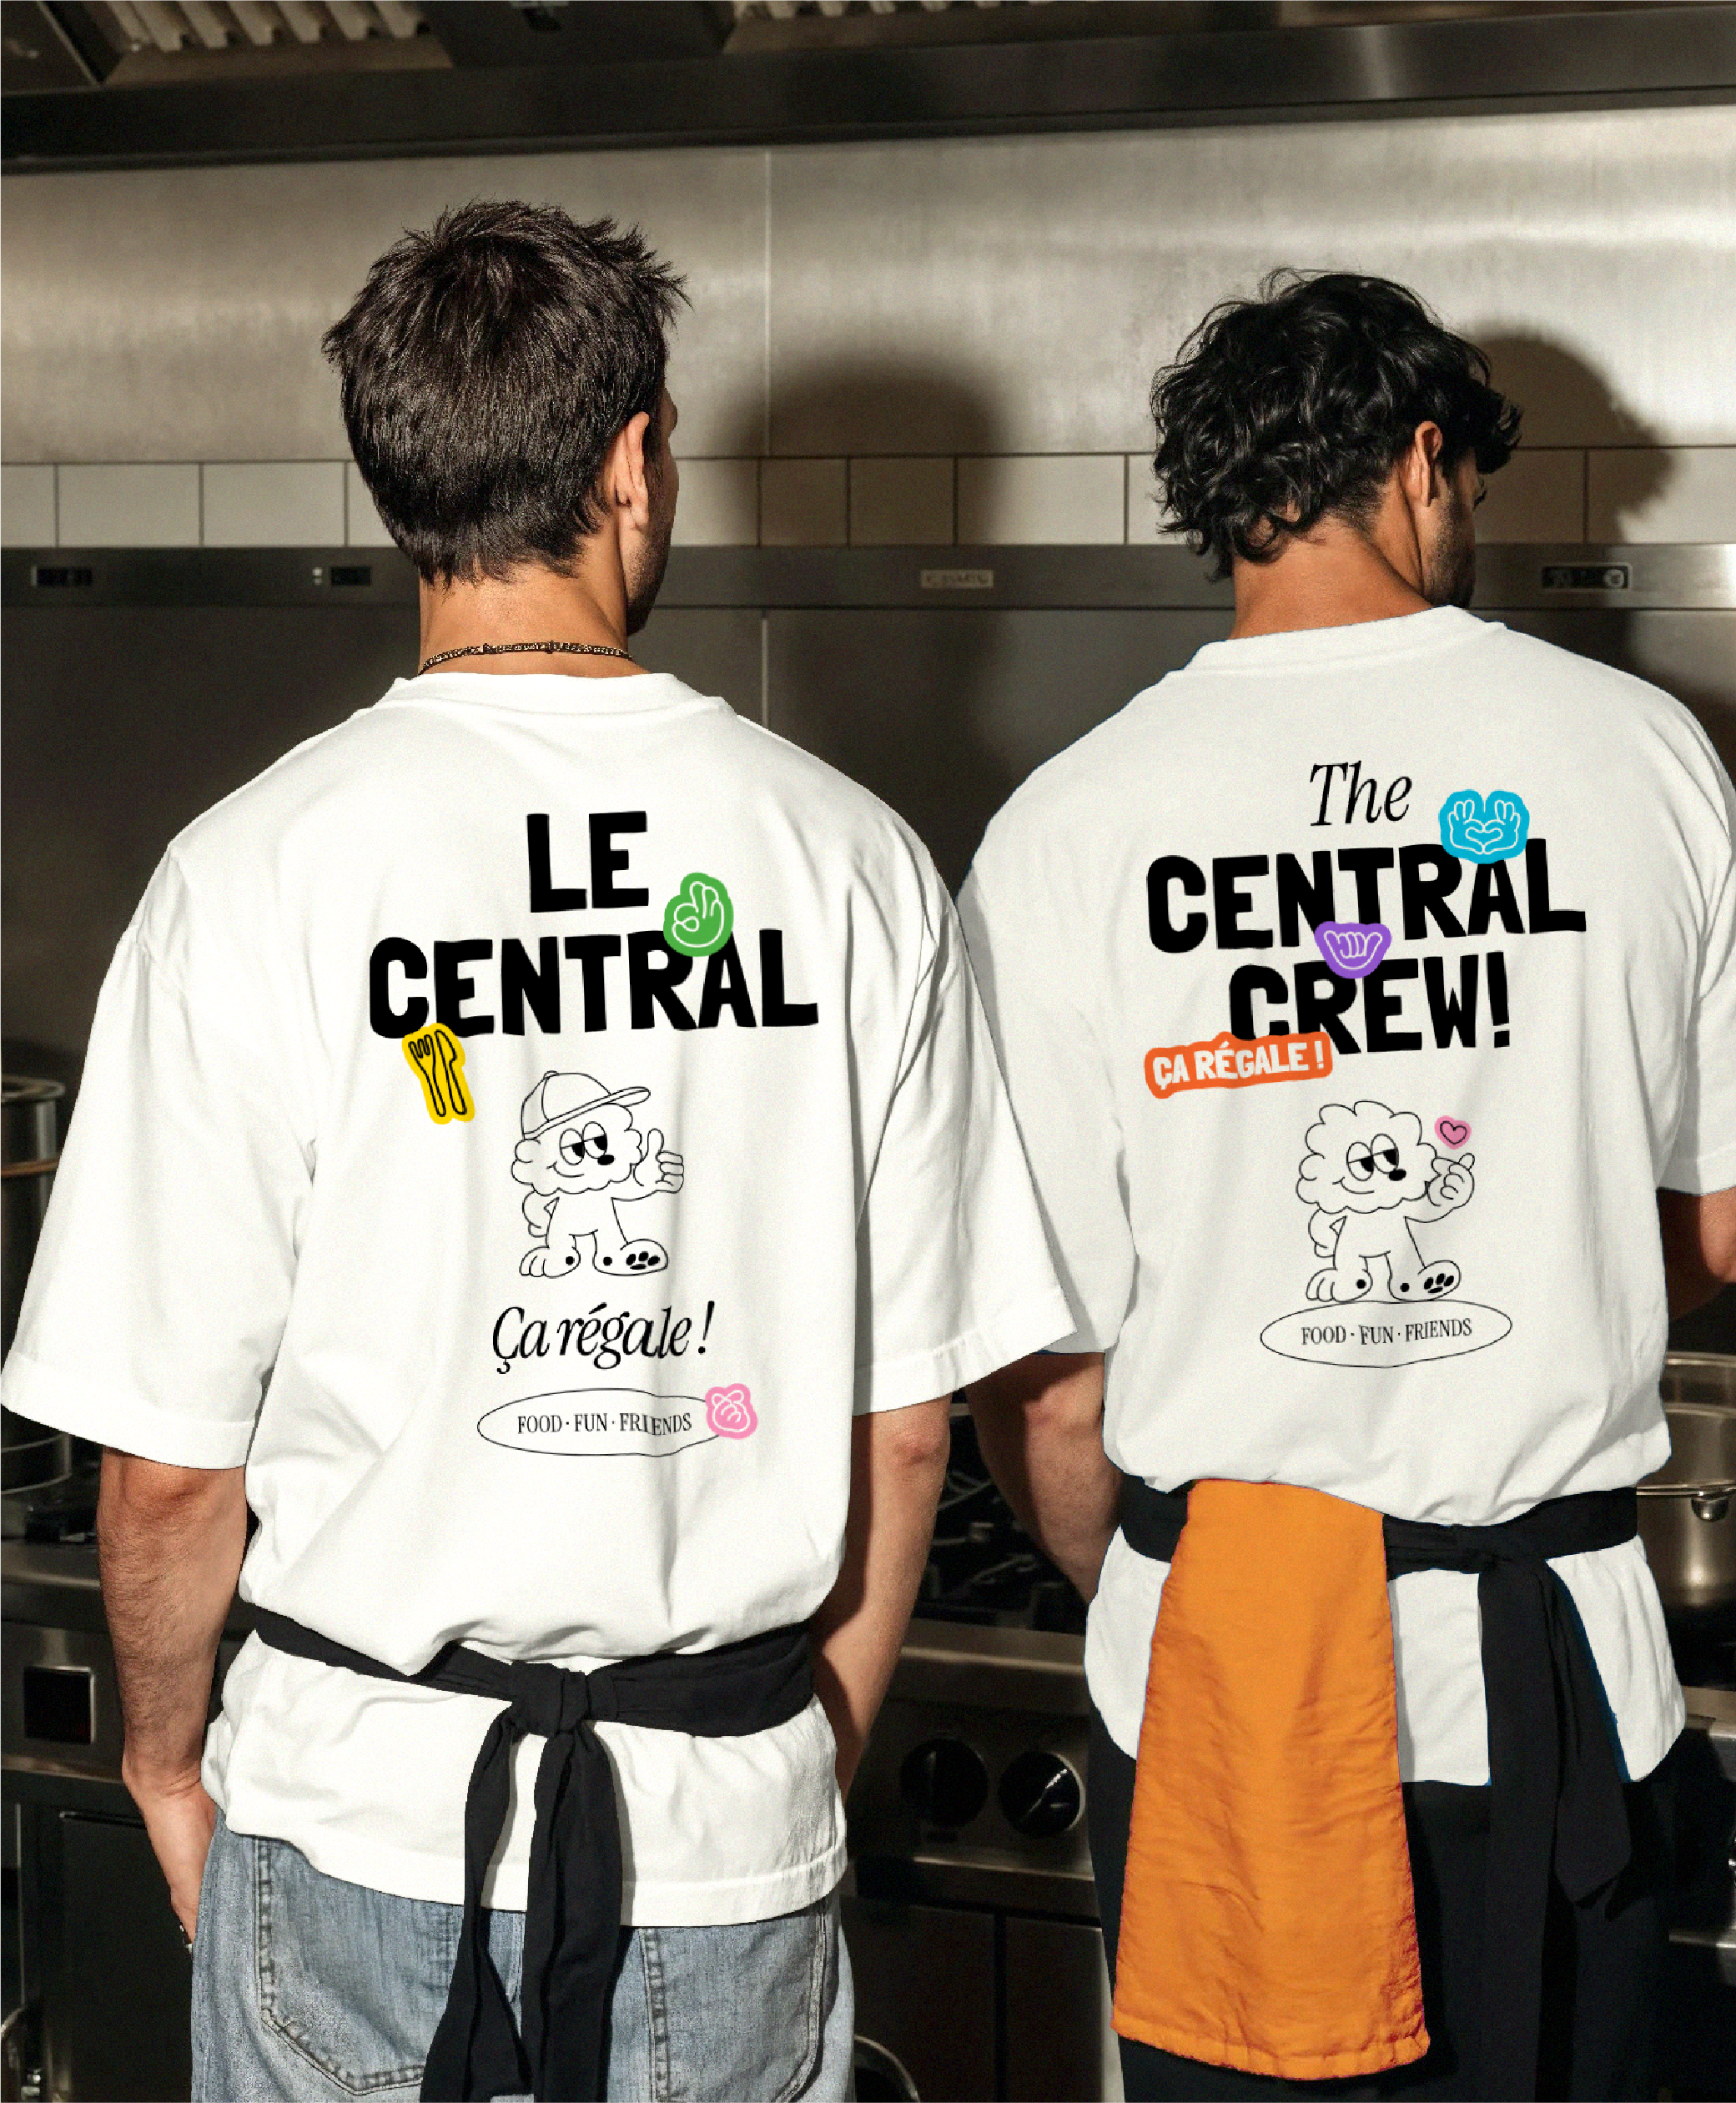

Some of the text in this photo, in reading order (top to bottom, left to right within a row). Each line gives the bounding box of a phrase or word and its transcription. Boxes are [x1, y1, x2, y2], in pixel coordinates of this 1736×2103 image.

[1310, 760, 1412, 826] The
[526, 811, 649, 913] LE
[1146, 838, 1586, 953] CENTRAL
[370, 928, 818, 1039] CENTRAL
[1229, 951, 1510, 1054] CREW!
[1152, 1054, 1190, 1090] ÇA
[492, 1306, 550, 1374] Ça
[1301, 1317, 1472, 1346] FOOD FUN FRIENDS
[518, 1412, 692, 1436] FOOD FUN FRIENDS
